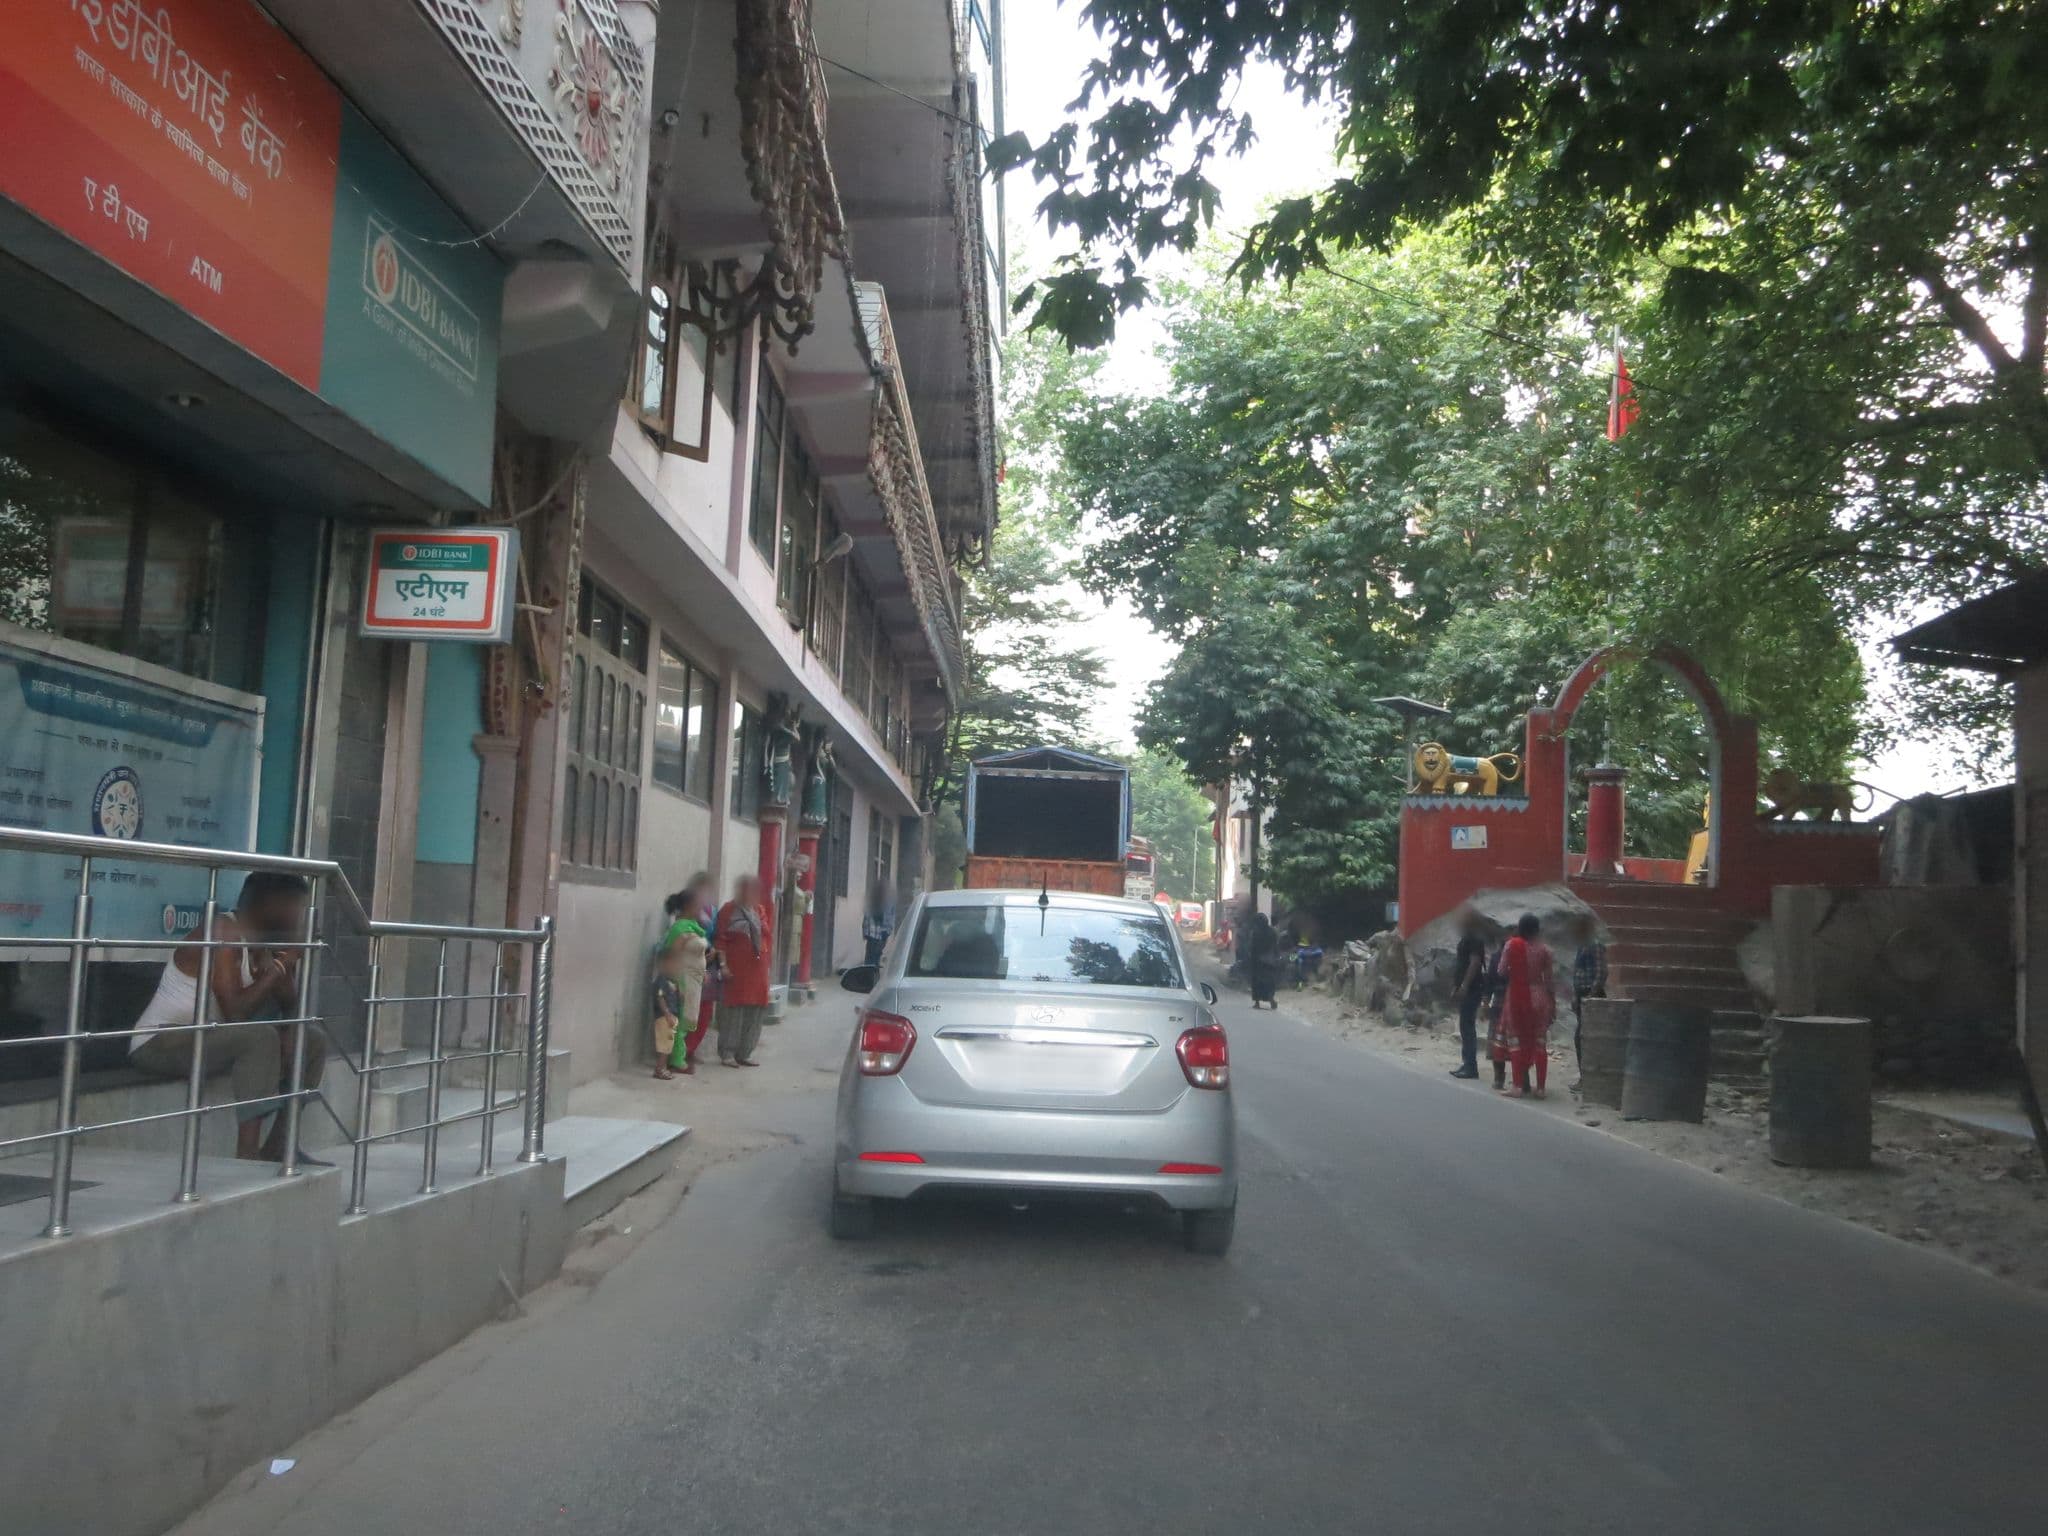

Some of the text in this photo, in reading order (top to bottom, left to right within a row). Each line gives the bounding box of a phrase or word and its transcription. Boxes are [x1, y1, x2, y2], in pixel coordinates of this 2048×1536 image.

[240, 92, 287, 180] बैंक
[190, 255, 222, 294] ATM
[401, 267, 474, 359] IDBI BANK
[418, 548, 469, 560] IDBI BANK
[396, 573, 469, 602] एटीएम
[413, 606, 446, 618] 24 घंटे
